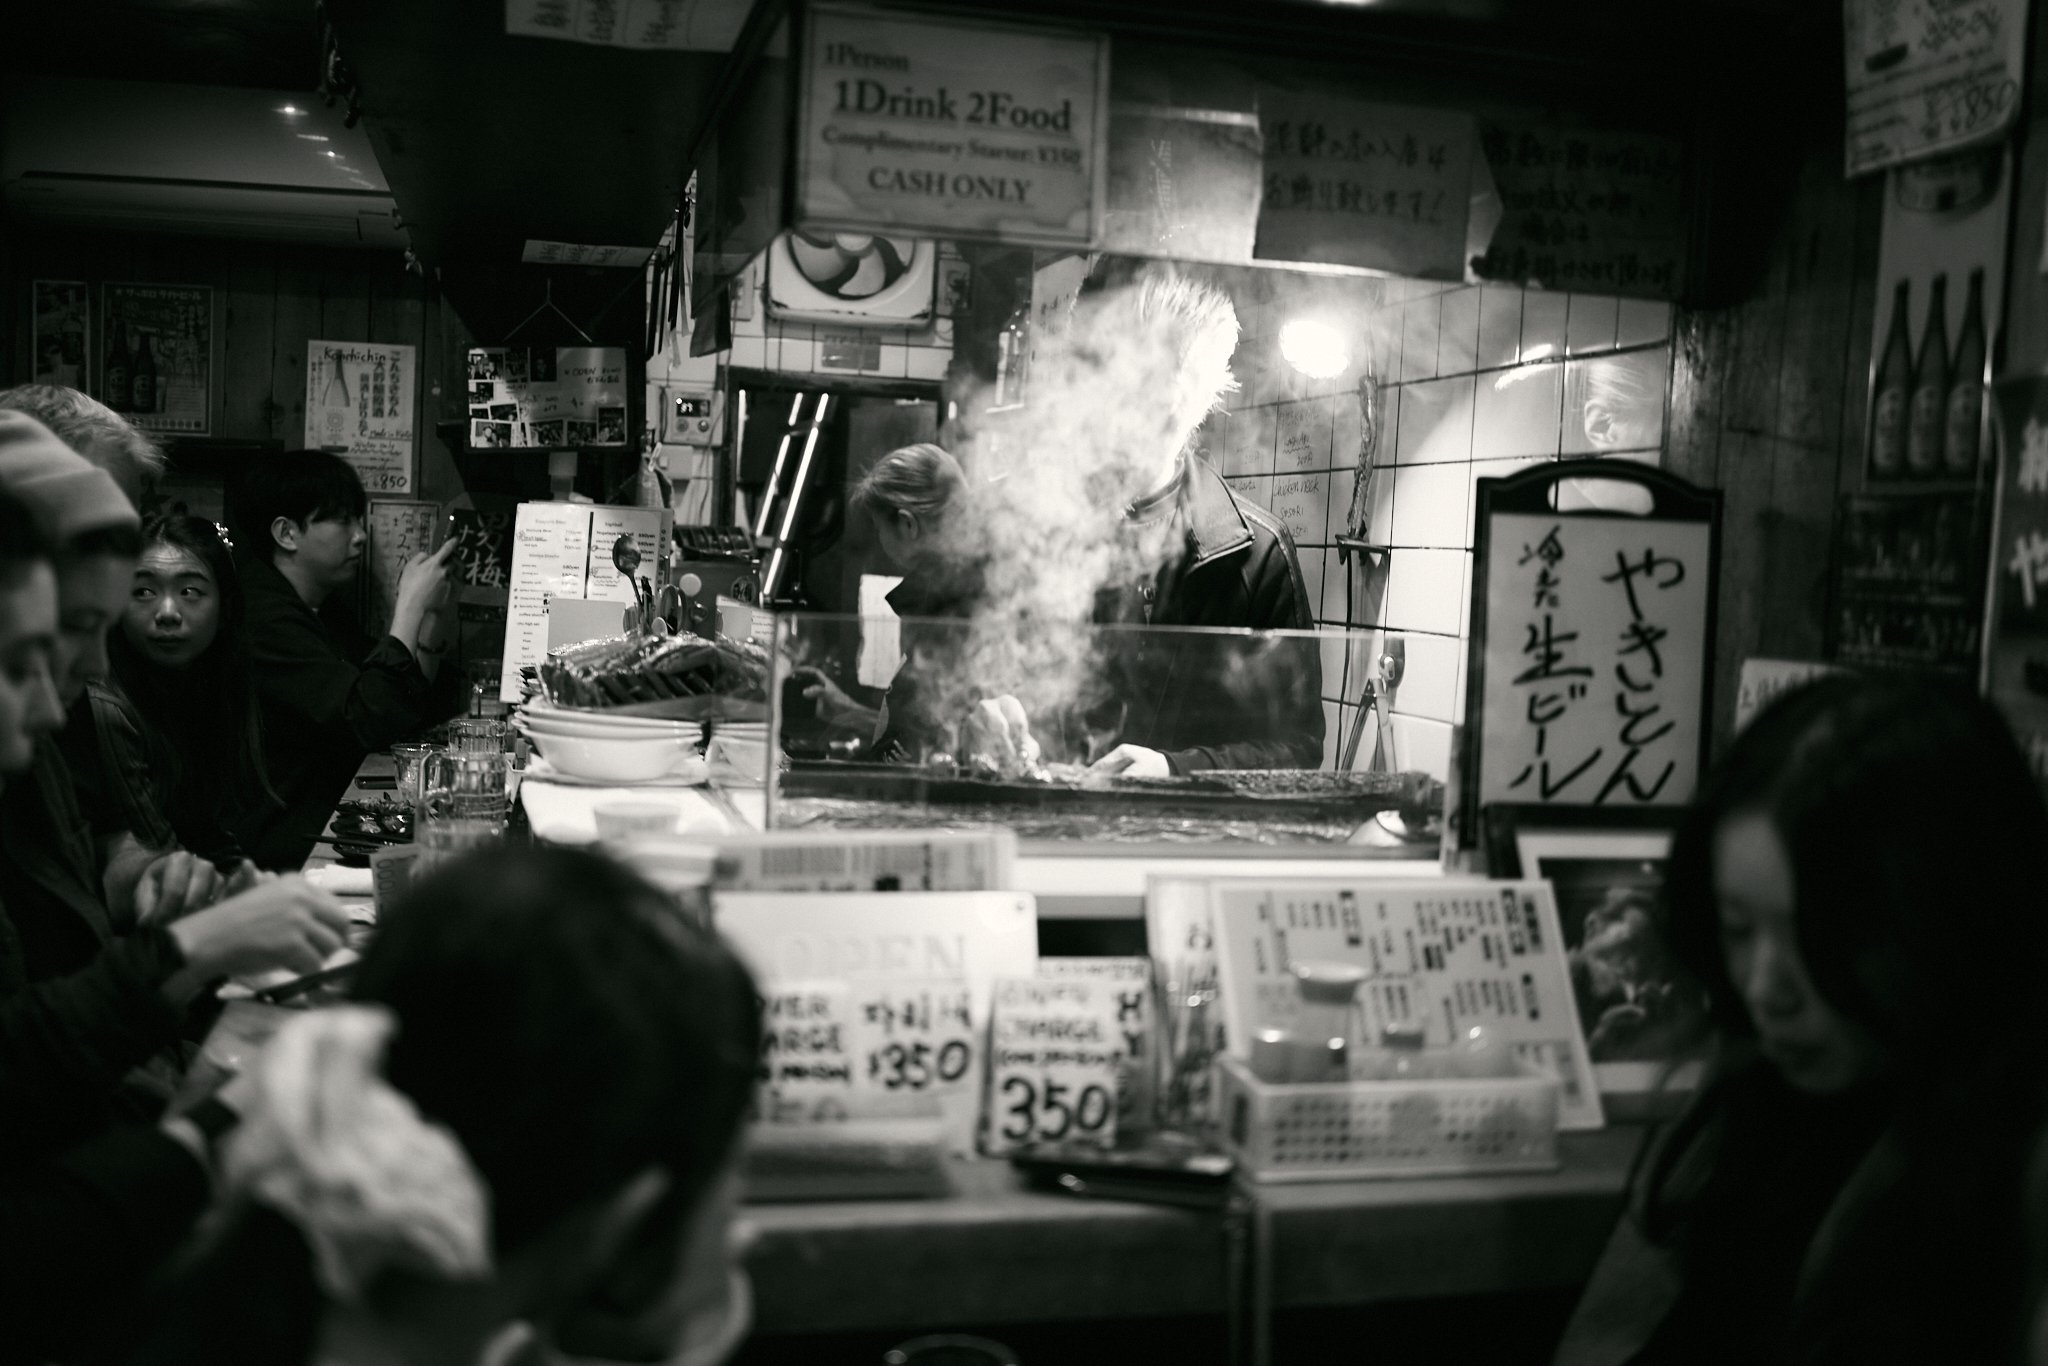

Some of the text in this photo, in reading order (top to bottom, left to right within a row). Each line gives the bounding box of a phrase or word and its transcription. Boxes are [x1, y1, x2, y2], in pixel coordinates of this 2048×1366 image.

[835, 78, 1072, 133] 1Drink 2Food
[868, 166, 1032, 204] CASH ONLY
[1594, 547, 1685, 807] やきとん
[1002, 1077, 1113, 1141] 350
